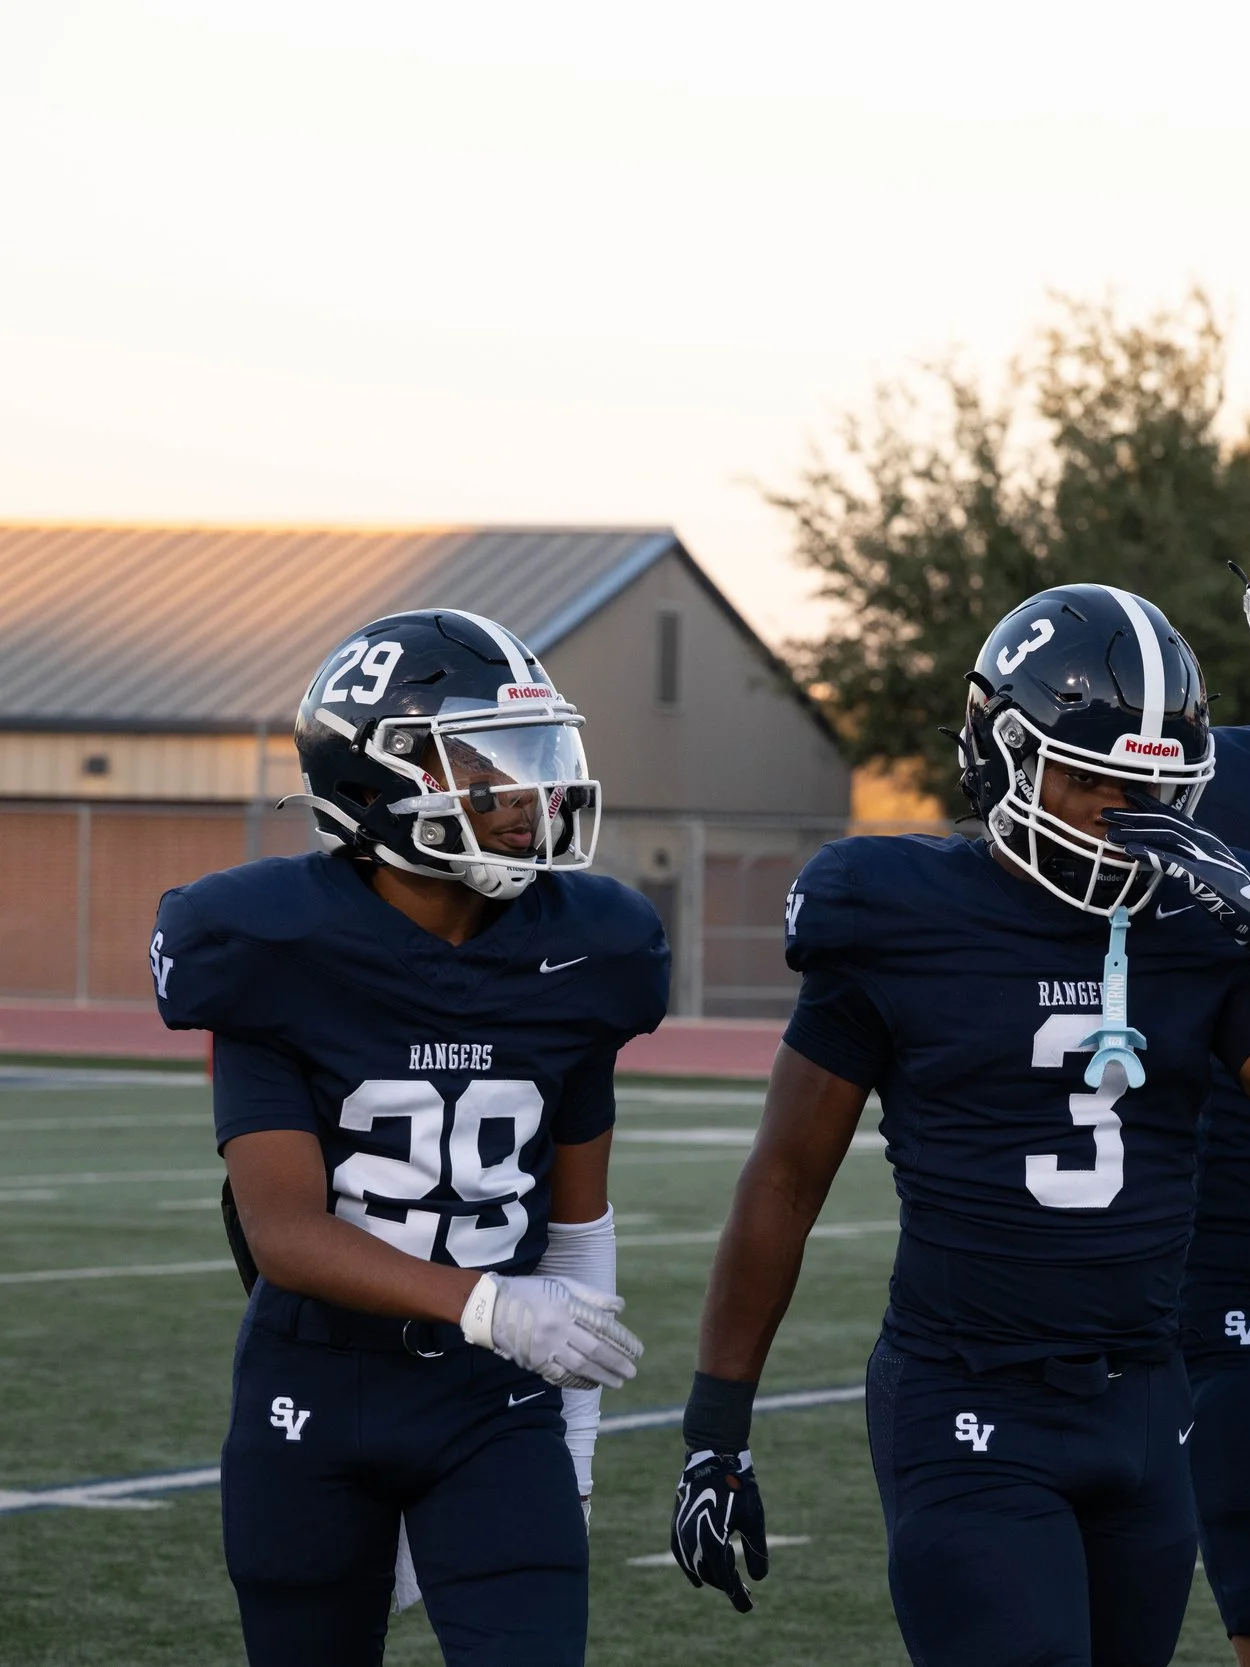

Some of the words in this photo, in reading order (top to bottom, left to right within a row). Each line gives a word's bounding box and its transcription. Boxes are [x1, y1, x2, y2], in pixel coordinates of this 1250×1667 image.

[996, 618, 1056, 676] 3
[321, 640, 405, 706] 29
[1125, 739, 1180, 758] Riddell
[150, 930, 175, 999] SV
[1038, 981, 1103, 1006] RANGE
[1107, 973, 1125, 1021] NXTRND
[409, 1043, 493, 1071] RANGERS
[1026, 1014, 1134, 1209] 3
[332, 1079, 545, 1268] 29
[270, 1396, 311, 1441] SV
[955, 1412, 995, 1451] SV
